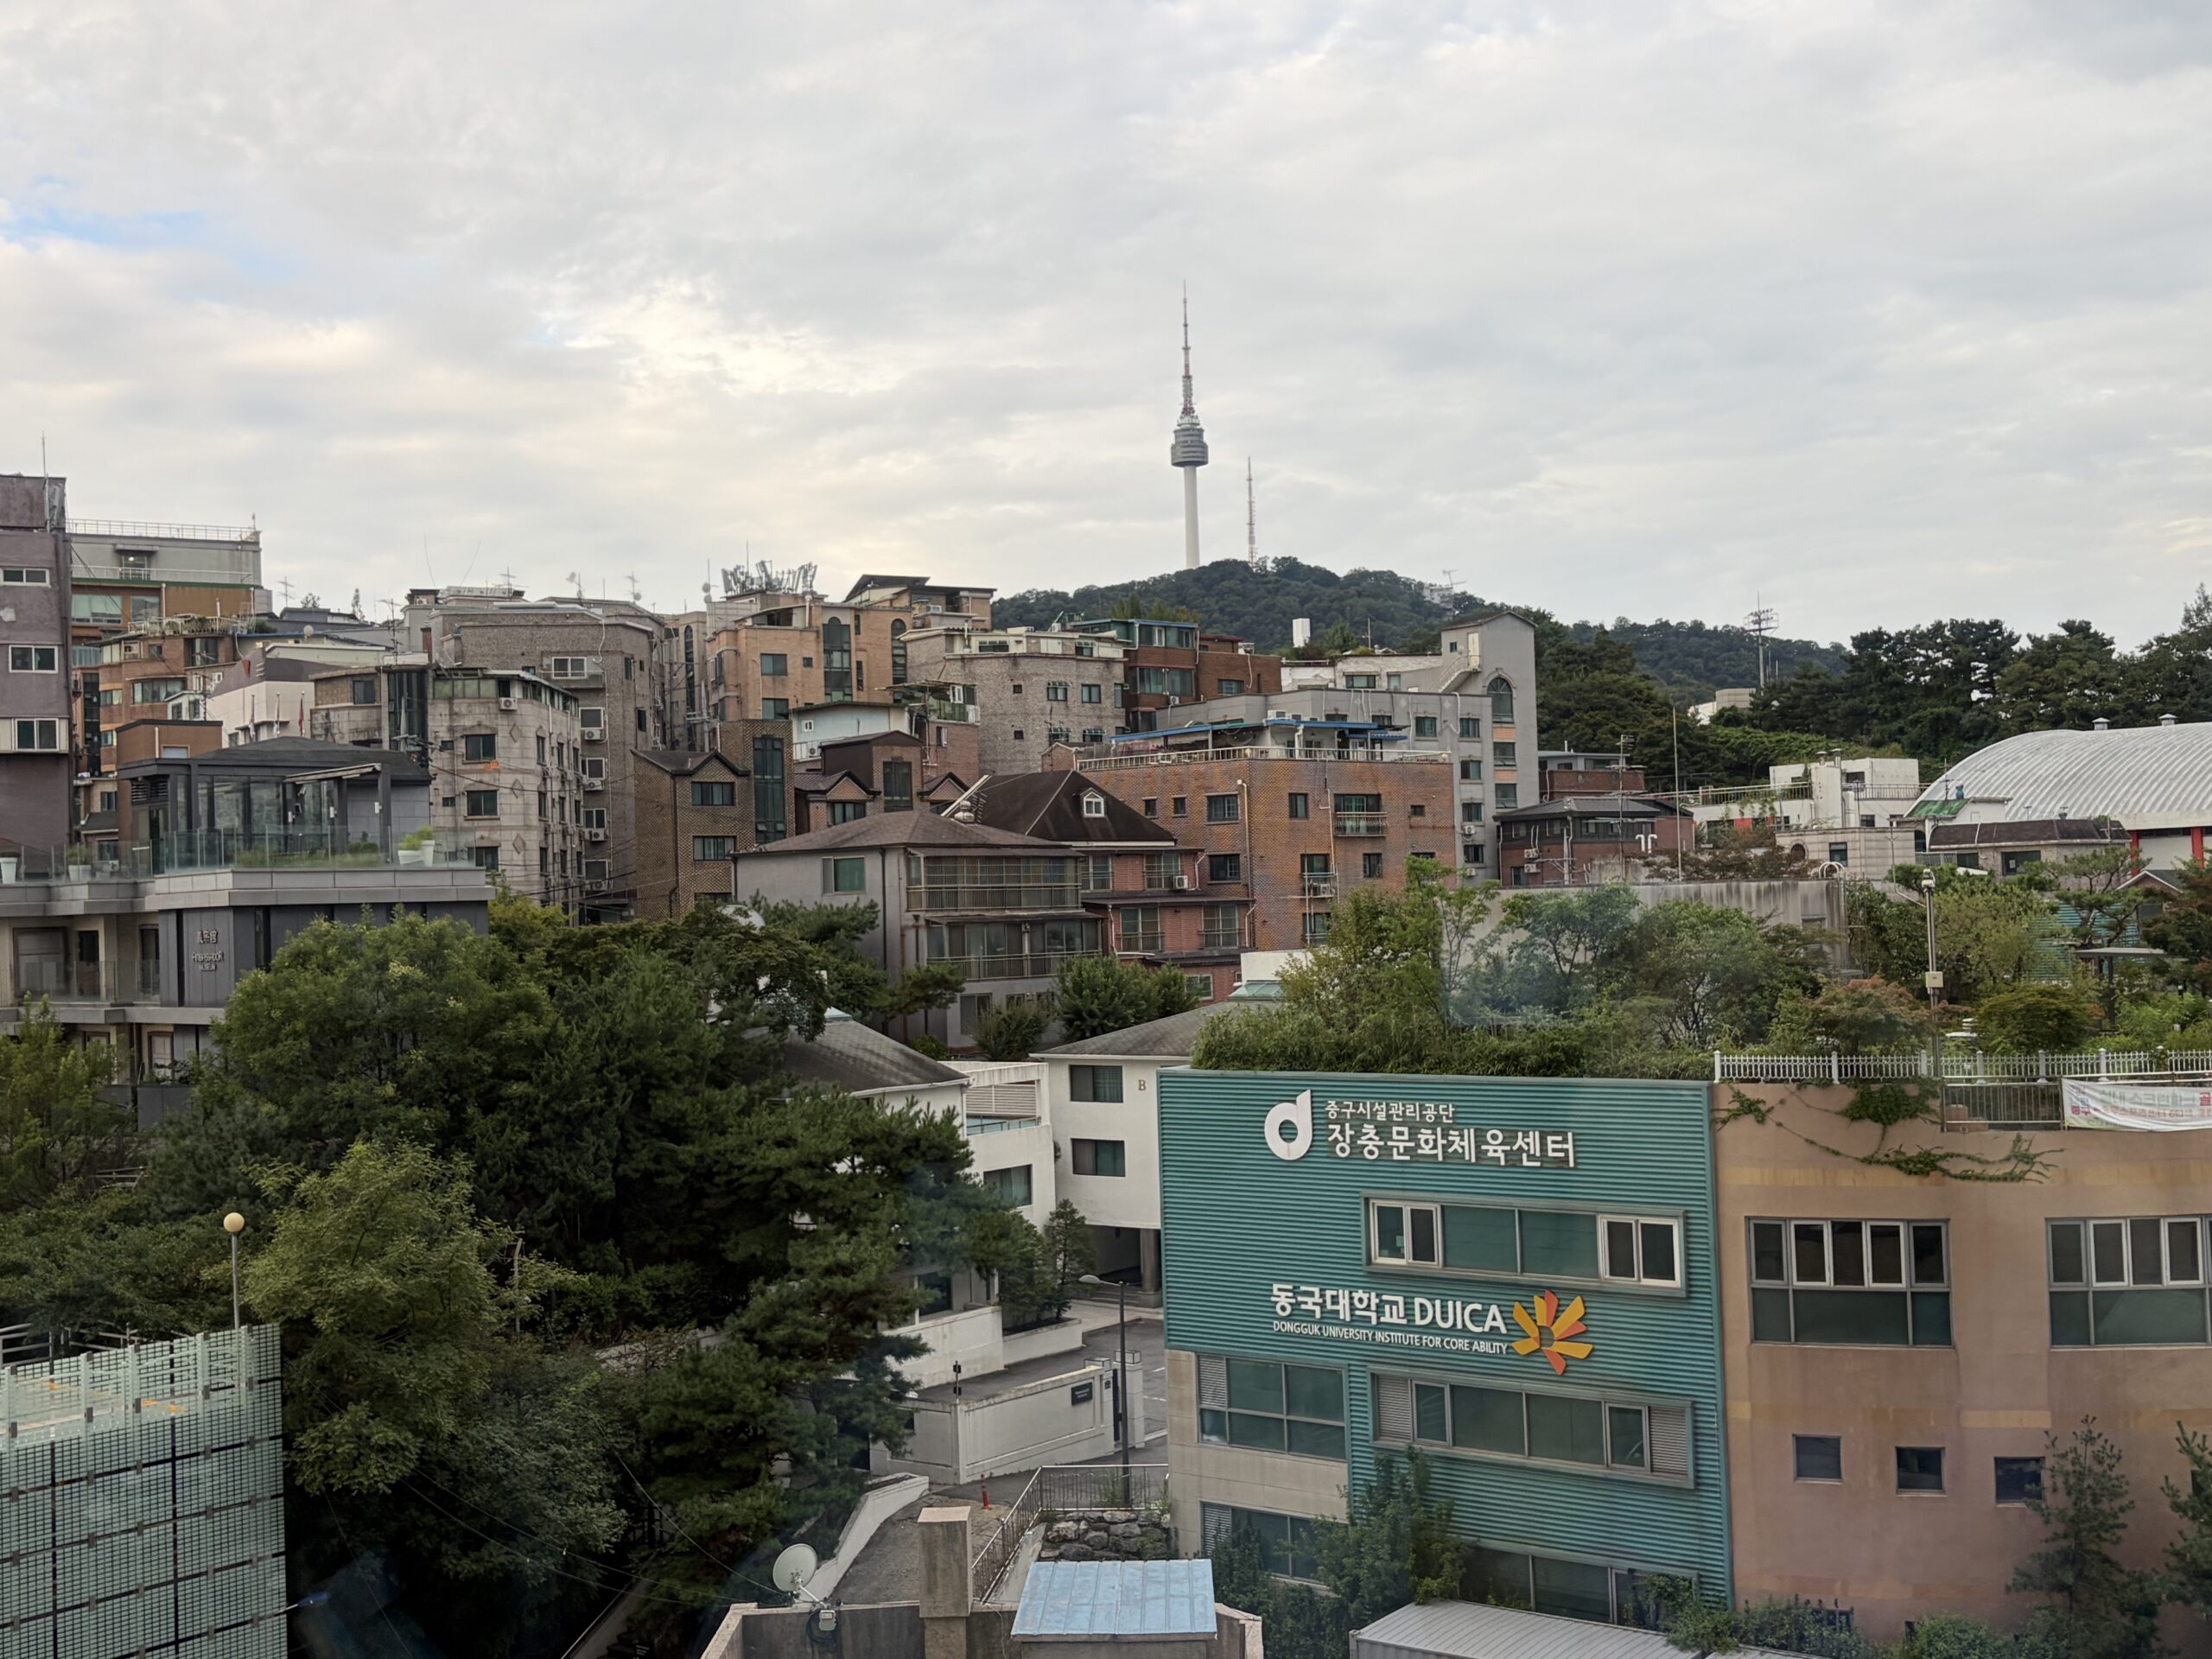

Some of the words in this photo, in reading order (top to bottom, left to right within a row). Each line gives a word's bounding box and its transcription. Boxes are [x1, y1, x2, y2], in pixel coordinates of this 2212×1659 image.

[1138, 1079, 1147, 1091] B
[1325, 1101, 1455, 1123] 중구시설관리공단
[1327, 1123, 1575, 1167] 장충문화체육센터
[1270, 1283, 1408, 1325] 동국대학교
[1414, 1297, 1508, 1334] DUICA
[1273, 1320, 1321, 1336] DONGGUK
[1322, 1325, 1373, 1342] UNIVERSITY
[1376, 1331, 1420, 1346] INSTITUTE
[1422, 1335, 1442, 1348] FOR
[1443, 1338, 1470, 1351] CORE
[1471, 1340, 1508, 1354] ABILITY
